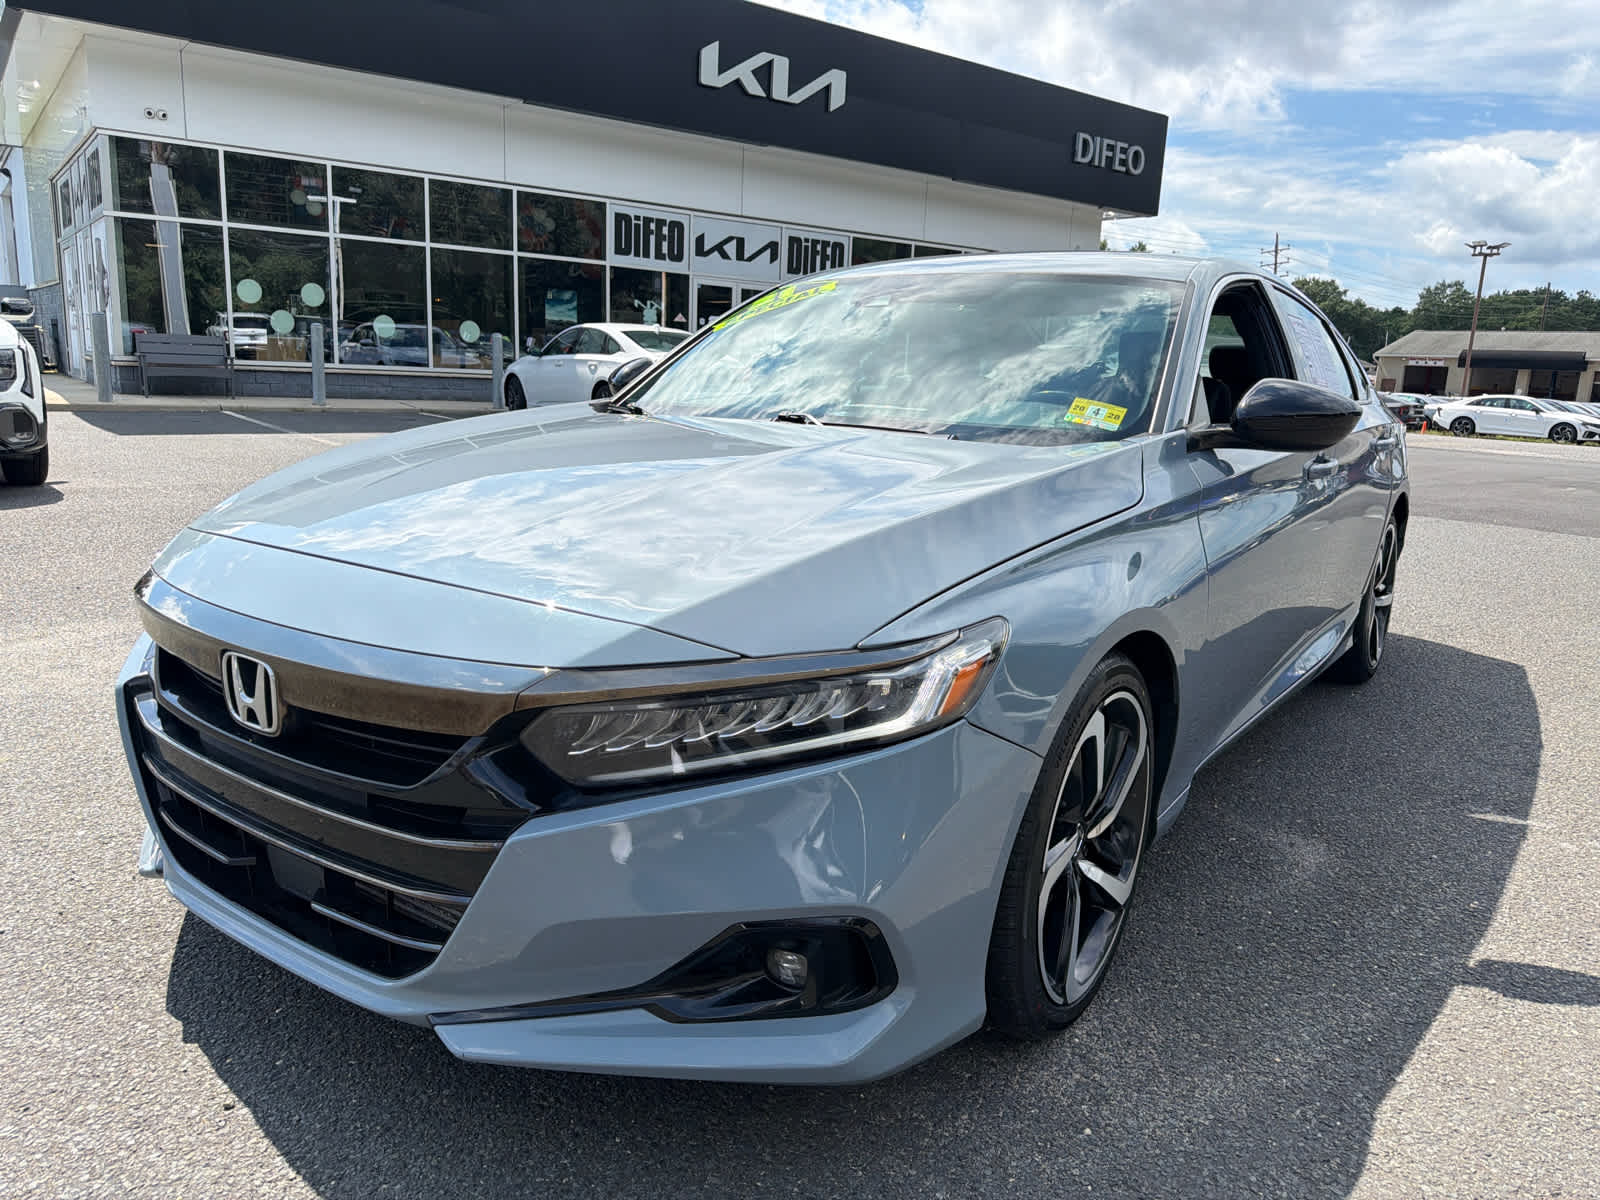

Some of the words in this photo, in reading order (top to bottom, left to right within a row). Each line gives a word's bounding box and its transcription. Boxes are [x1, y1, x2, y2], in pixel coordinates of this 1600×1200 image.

[699, 40, 847, 112] KIA
[1073, 131, 1146, 176] DIFEO
[695, 232, 779, 264] KIA
